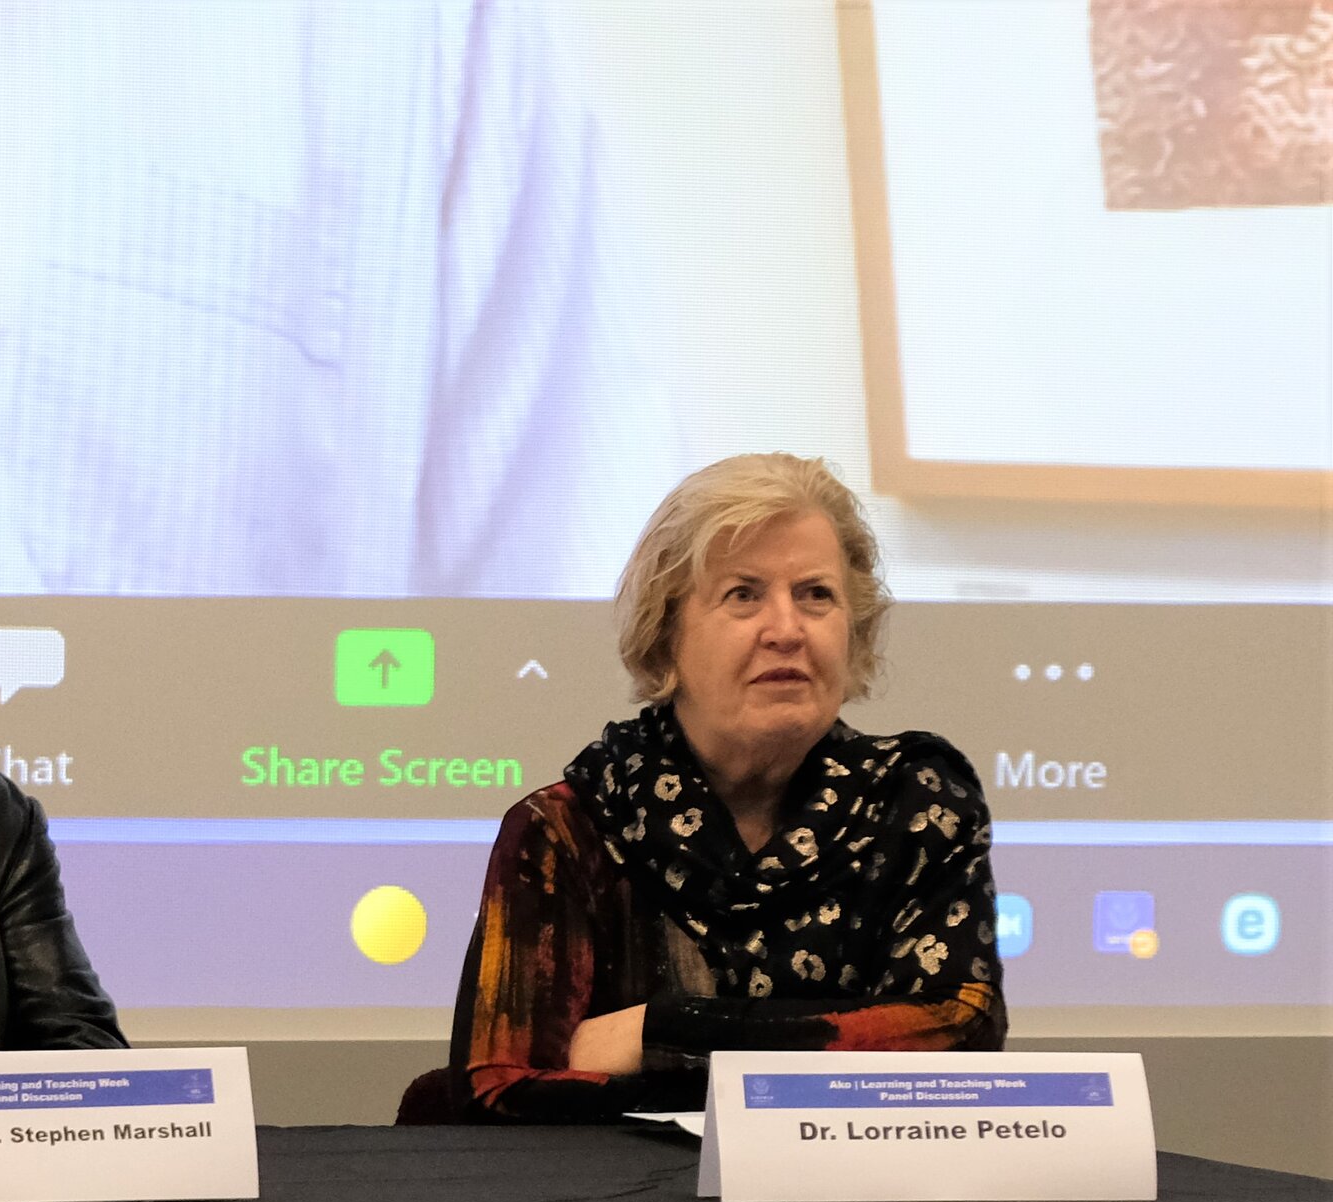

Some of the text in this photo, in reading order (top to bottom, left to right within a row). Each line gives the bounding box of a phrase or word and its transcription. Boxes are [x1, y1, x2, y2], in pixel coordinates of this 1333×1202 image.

[241, 746, 523, 787] Share Screen
[994, 751, 1108, 790] More
[21, 1080, 43, 1090] and
[45, 1077, 97, 1090] Teaching
[861, 1079, 912, 1091] Learning
[915, 1080, 937, 1088] and
[940, 1079, 992, 1091] Teaching
[21, 1091, 83, 1102] Discussion
[880, 1092, 979, 1101] Panel Discussion
[10, 1124, 105, 1144] Stephen
[114, 1121, 212, 1140] Marshall
[800, 1120, 1067, 1140] Dr. Lorraine Petelo
